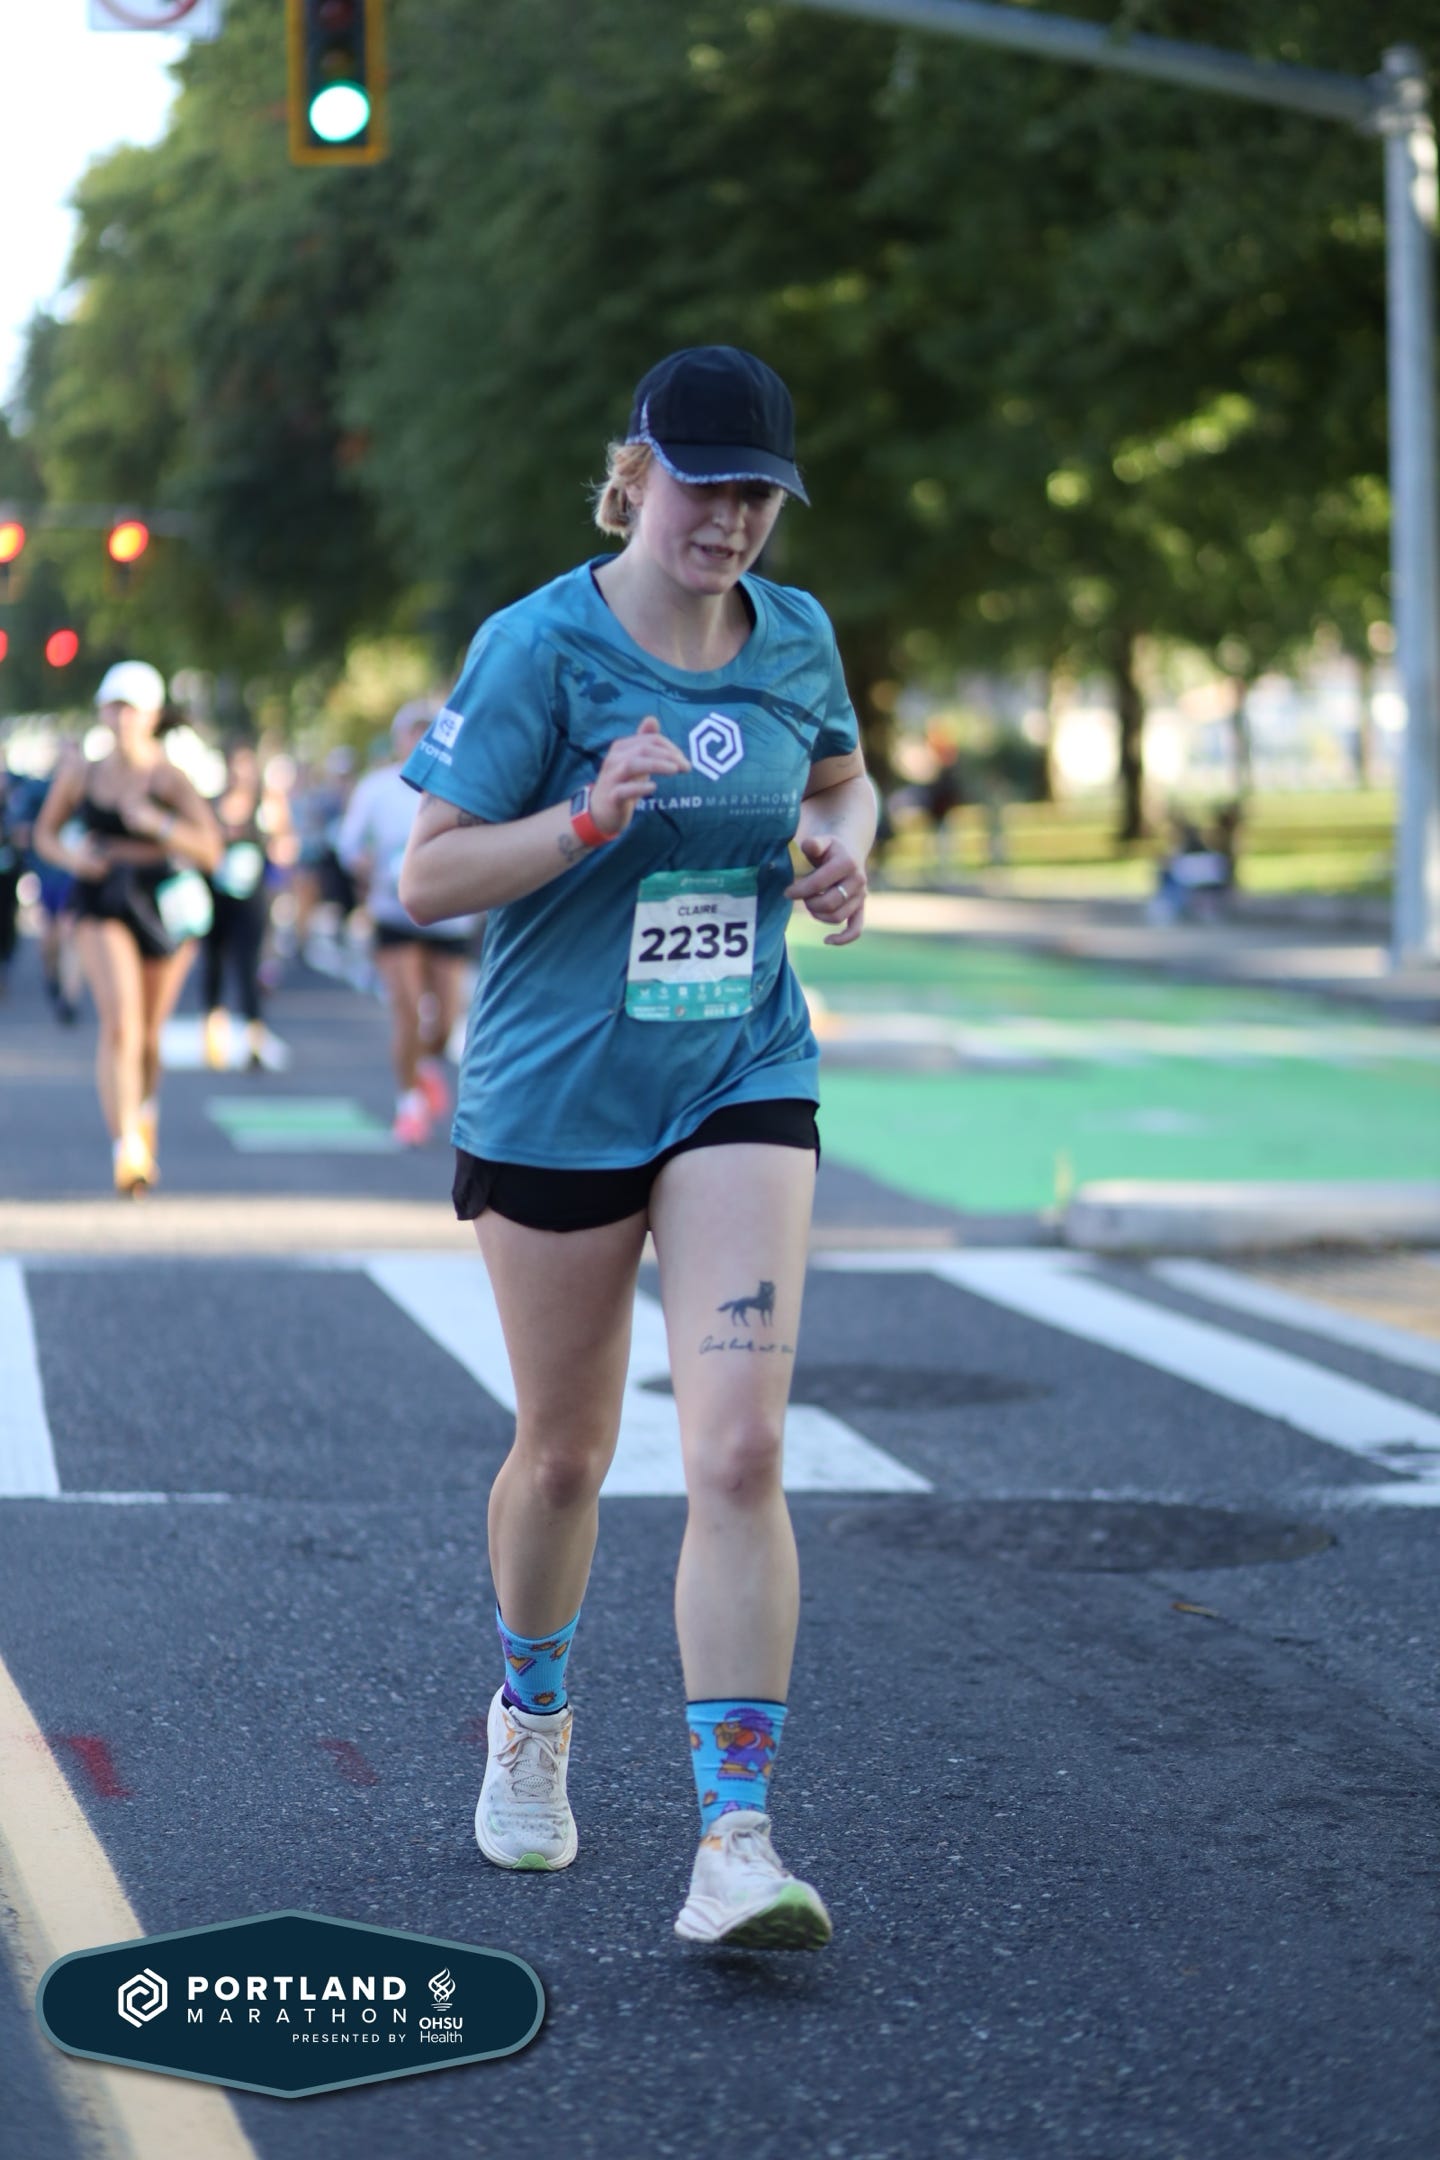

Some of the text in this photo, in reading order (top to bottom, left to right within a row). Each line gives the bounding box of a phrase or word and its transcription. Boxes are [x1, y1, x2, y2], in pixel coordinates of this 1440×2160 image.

[634, 796, 702, 811] RTLAND
[678, 904, 718, 916] CLAIRE
[639, 922, 748, 962] 2235
